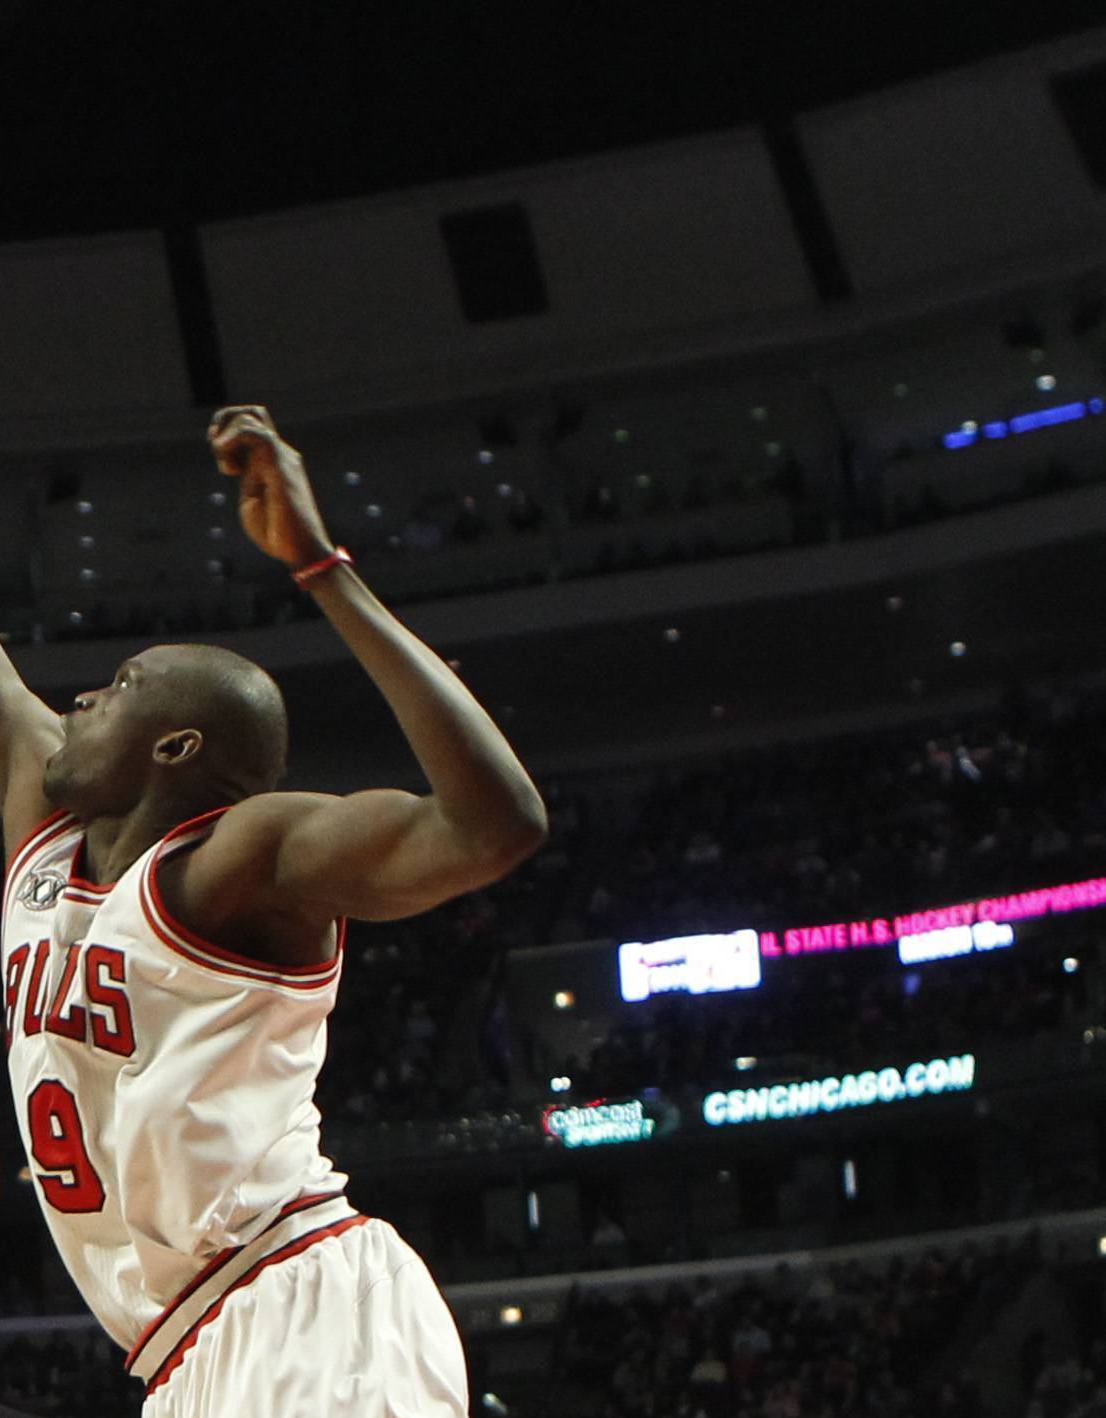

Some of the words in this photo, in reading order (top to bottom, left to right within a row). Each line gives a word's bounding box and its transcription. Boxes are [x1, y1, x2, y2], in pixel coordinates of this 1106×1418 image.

[784, 923, 847, 955] STATE
[894, 903, 975, 938] HOCKEY
[976, 877, 1106, 921] CHAMPIONS
[702, 1053, 975, 1126] CSNCHICAGO.COM
[26, 1078, 107, 1214] 9
